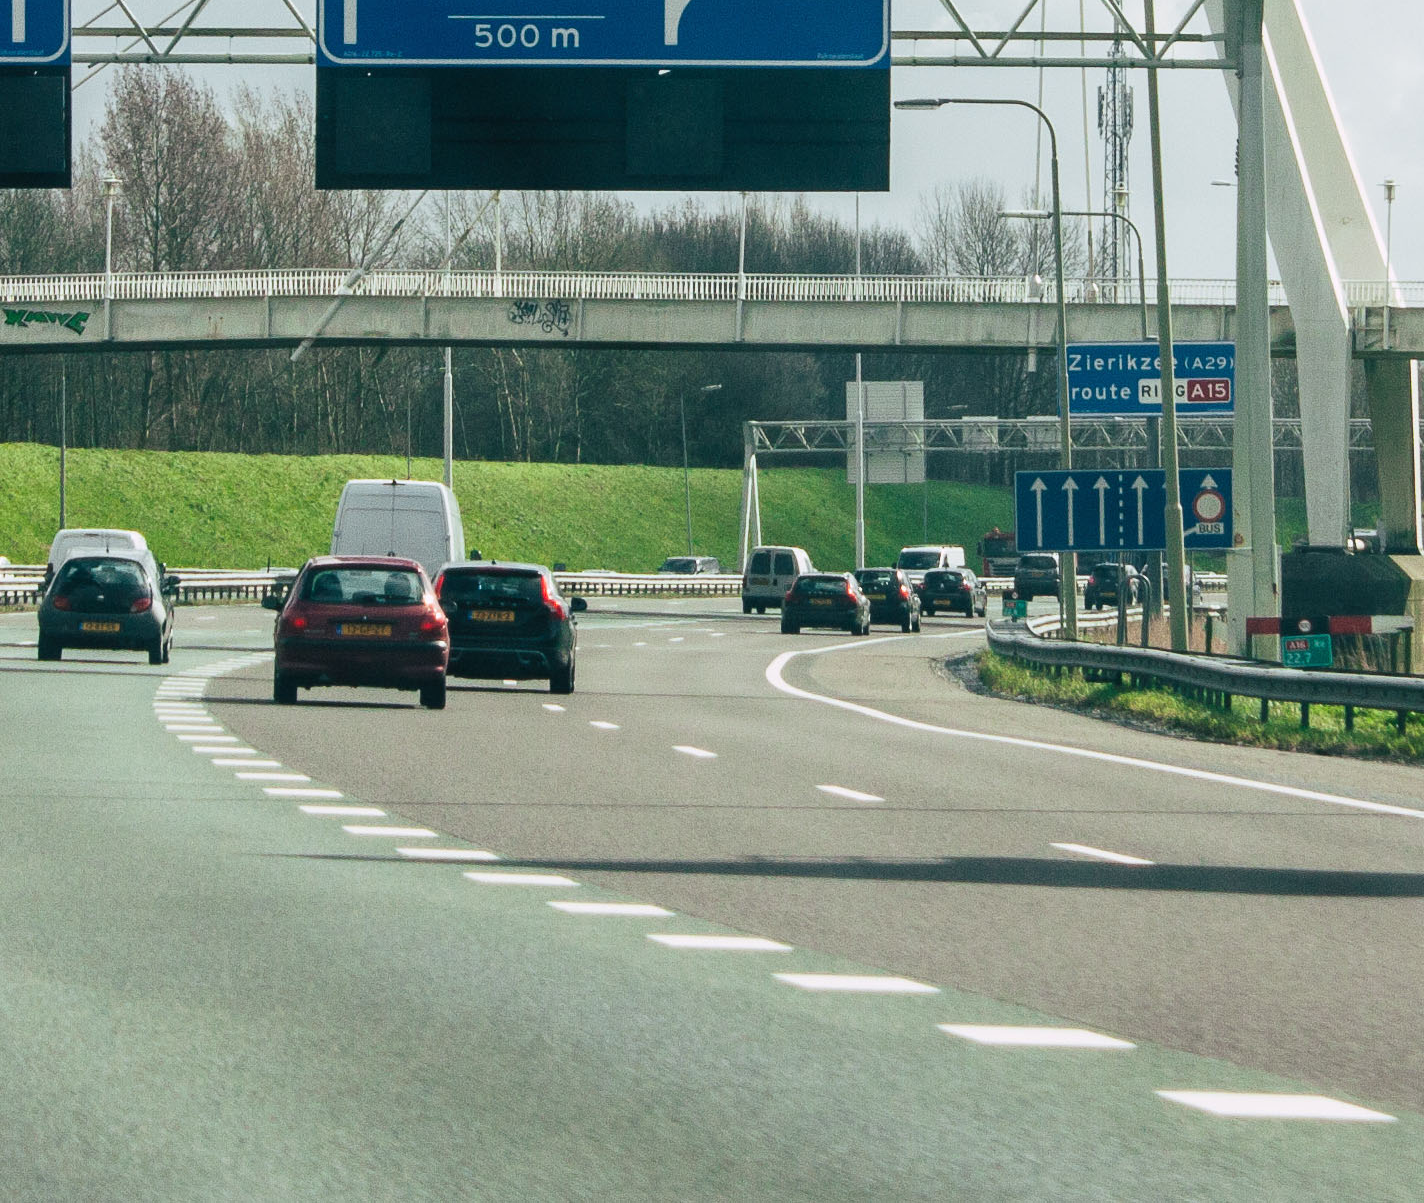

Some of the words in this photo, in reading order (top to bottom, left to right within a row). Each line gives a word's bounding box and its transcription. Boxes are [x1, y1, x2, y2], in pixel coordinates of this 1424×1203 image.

[475, 23, 540, 48] 500
[551, 27, 580, 48] m
[1184, 356, 1234, 371] (A29)
[1072, 383, 1132, 400] route
[1141, 384, 1186, 398] RIG
[1191, 383, 1226, 399] A15
[1198, 524, 1222, 533] BUS
